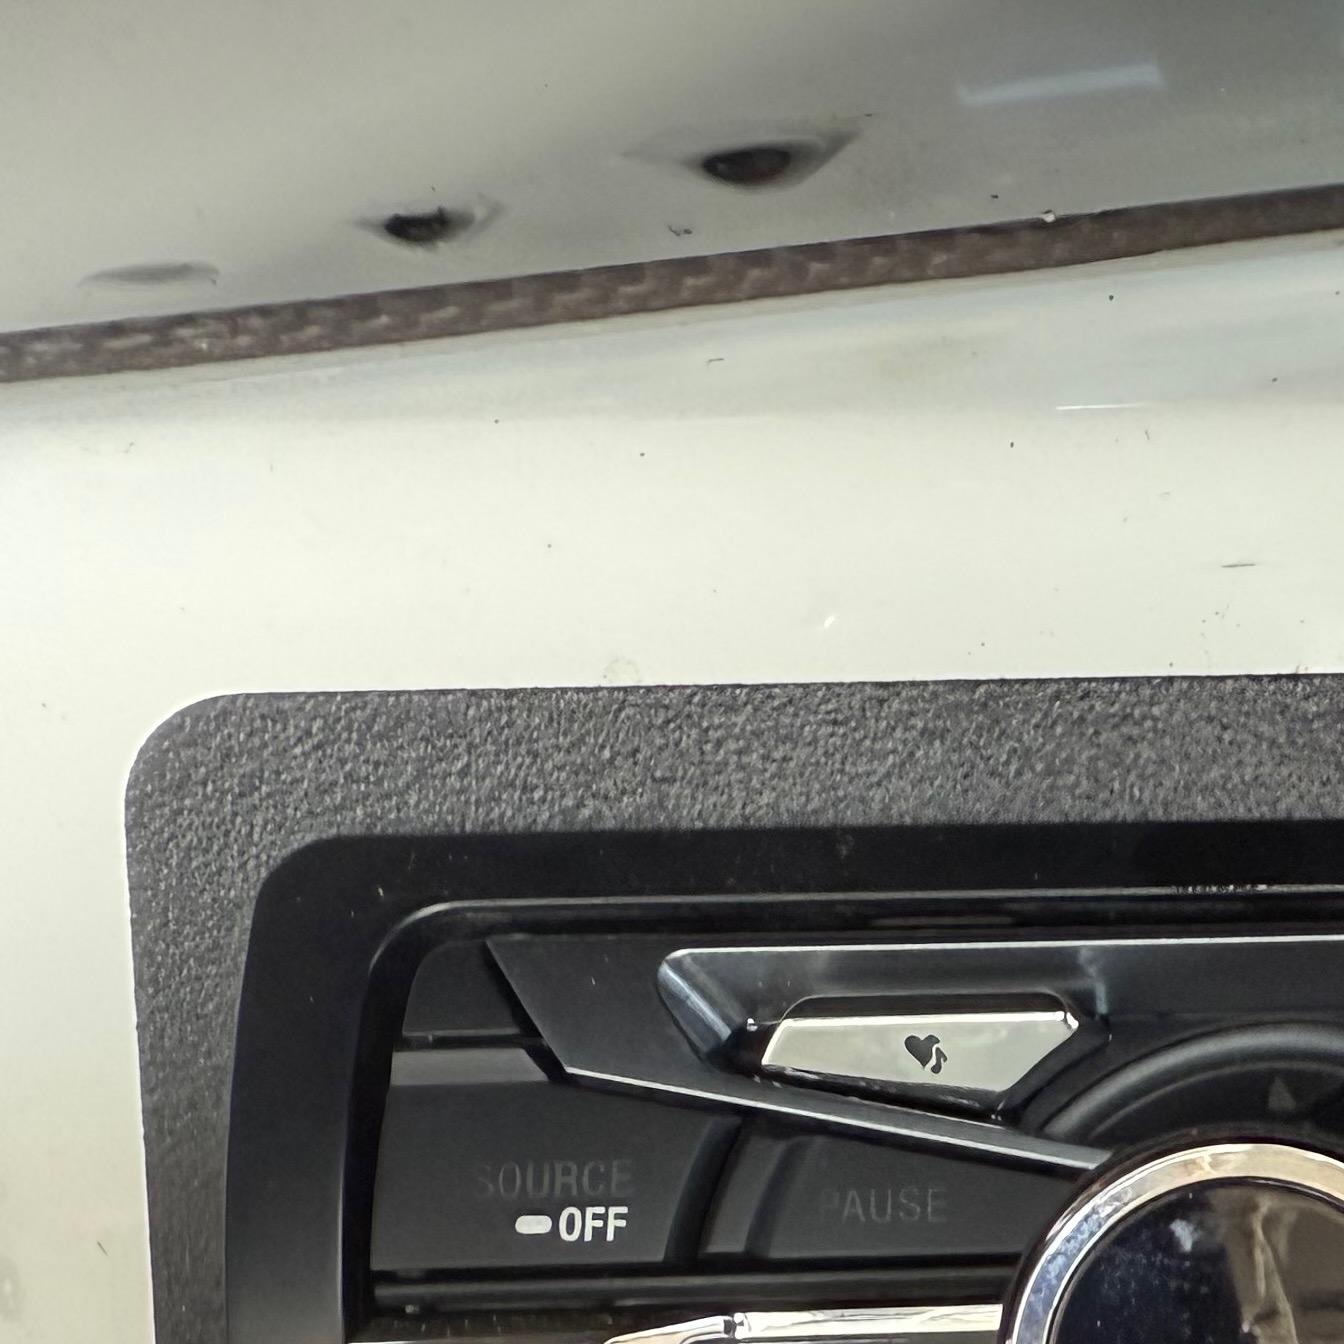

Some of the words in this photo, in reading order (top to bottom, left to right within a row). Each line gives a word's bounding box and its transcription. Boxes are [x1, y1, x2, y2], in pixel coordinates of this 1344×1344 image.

[474, 1158, 636, 1200] SOURCE
[558, 1206, 630, 1242] OFF
[819, 1185, 949, 1225] PAUSE
